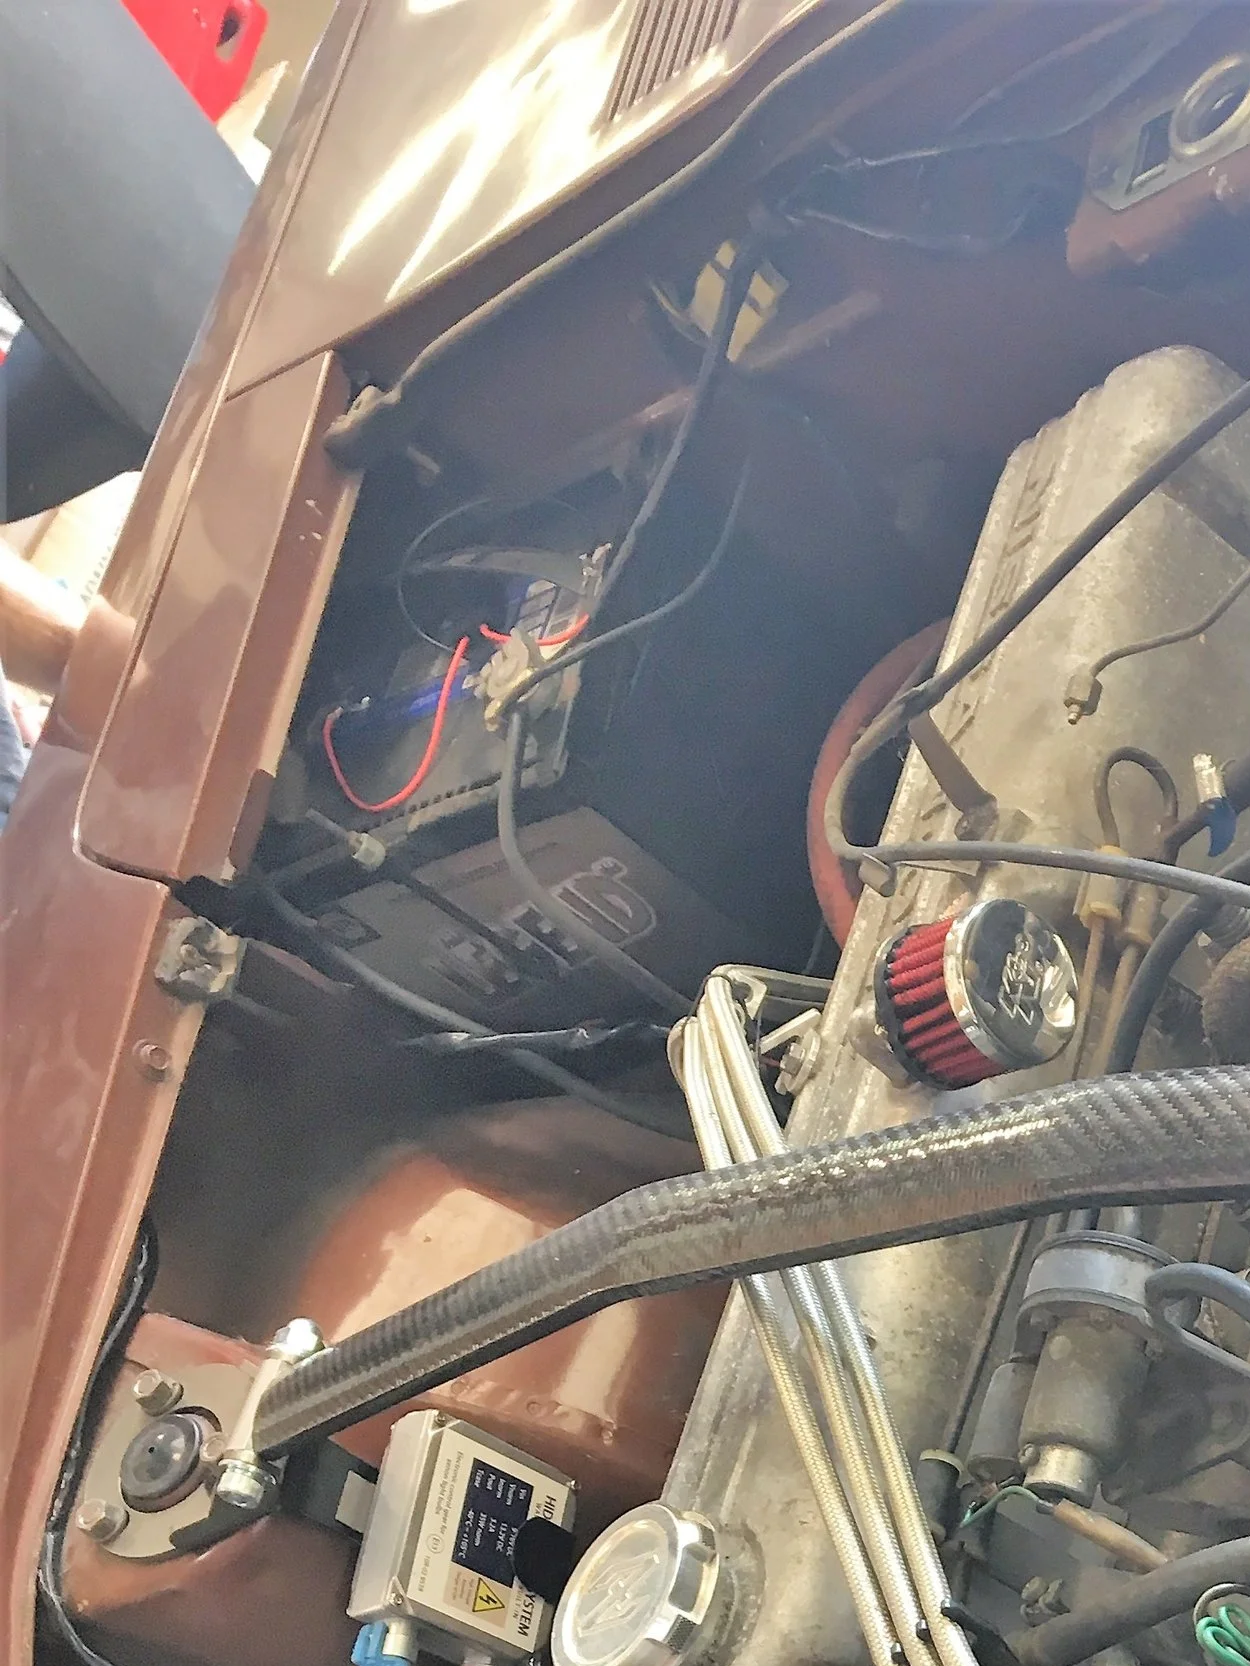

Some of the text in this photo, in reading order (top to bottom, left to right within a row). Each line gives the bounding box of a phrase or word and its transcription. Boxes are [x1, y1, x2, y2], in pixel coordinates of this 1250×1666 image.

[451, 1451, 463, 1483] Electronic
[439, 1479, 448, 1496] light
[486, 1473, 495, 1490] Pout
[446, 1483, 455, 1508] control
[517, 1495, 556, 1636] HID YSTEM
